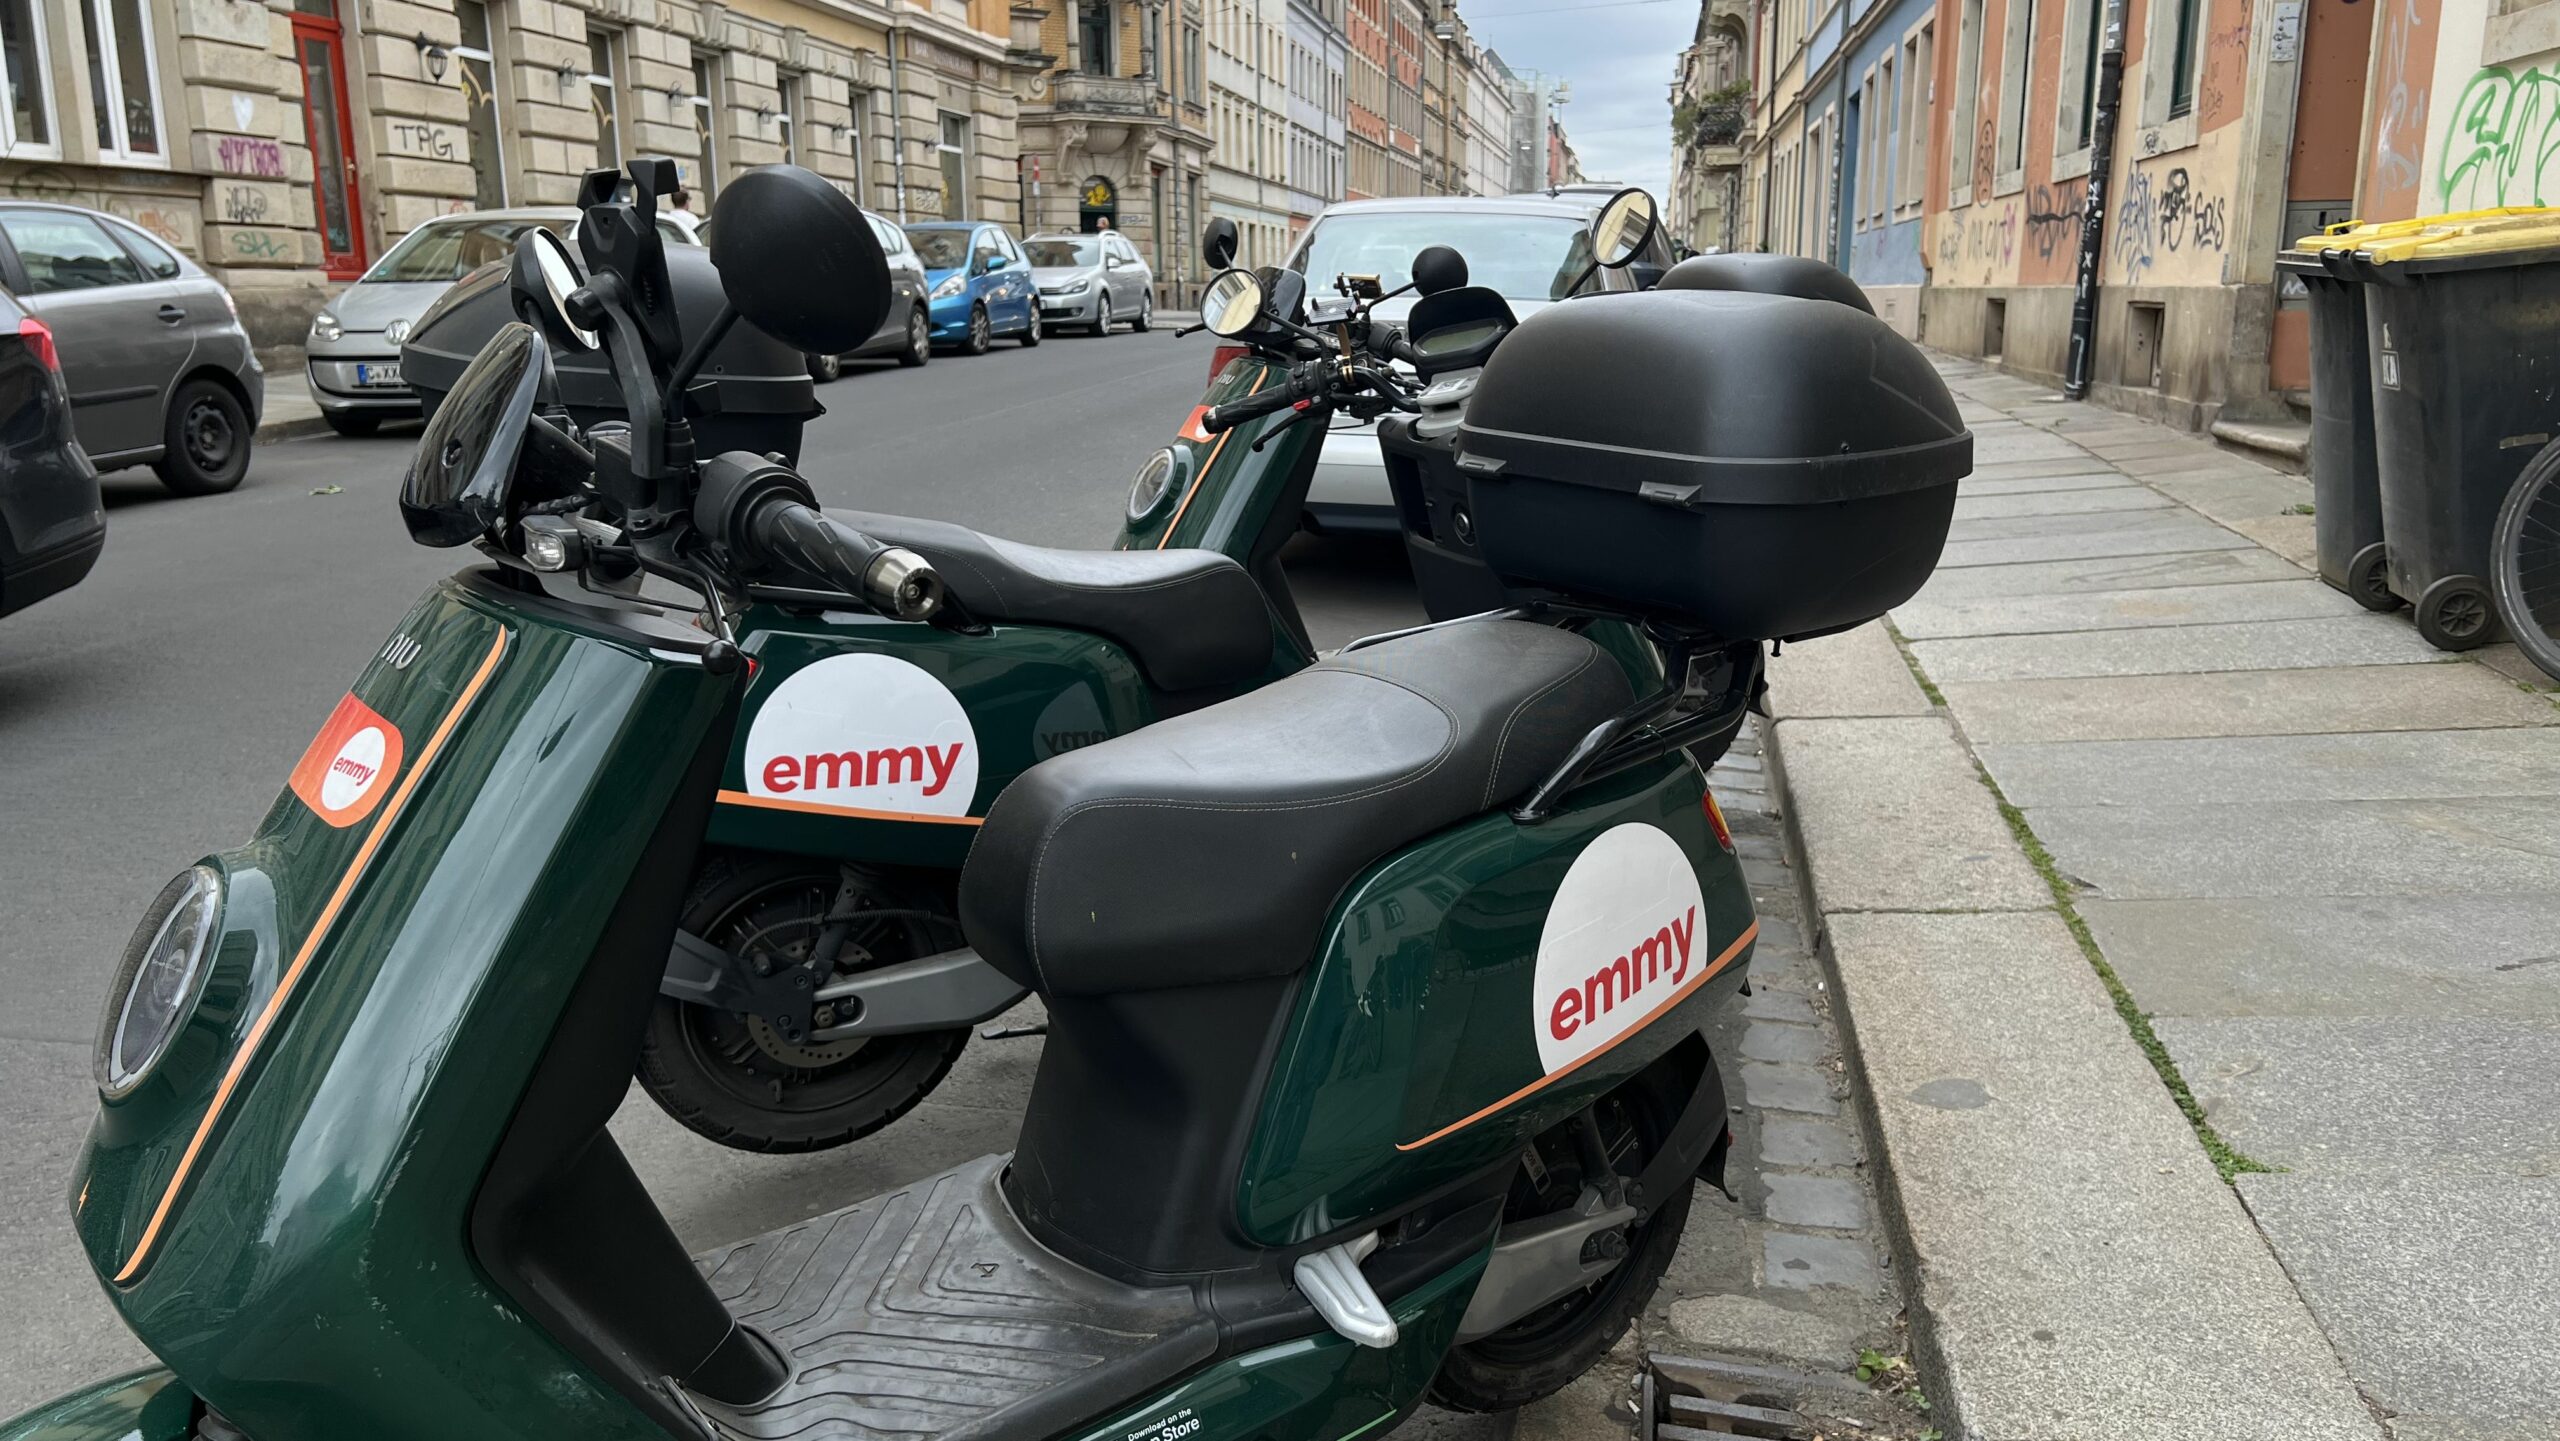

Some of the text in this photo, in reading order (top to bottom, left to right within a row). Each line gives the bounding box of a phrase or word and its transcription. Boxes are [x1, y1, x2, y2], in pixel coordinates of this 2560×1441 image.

[394, 125, 454, 161] TPG
[333, 756, 376, 787] emmy
[763, 742, 963, 796] emmy
[1550, 905, 1695, 1041] emmy
[1127, 1418, 1167, 1441] Download
[1167, 1413, 1178, 1424] on
[1178, 1407, 1192, 1420] the
[1161, 1418, 1201, 1441] Store
